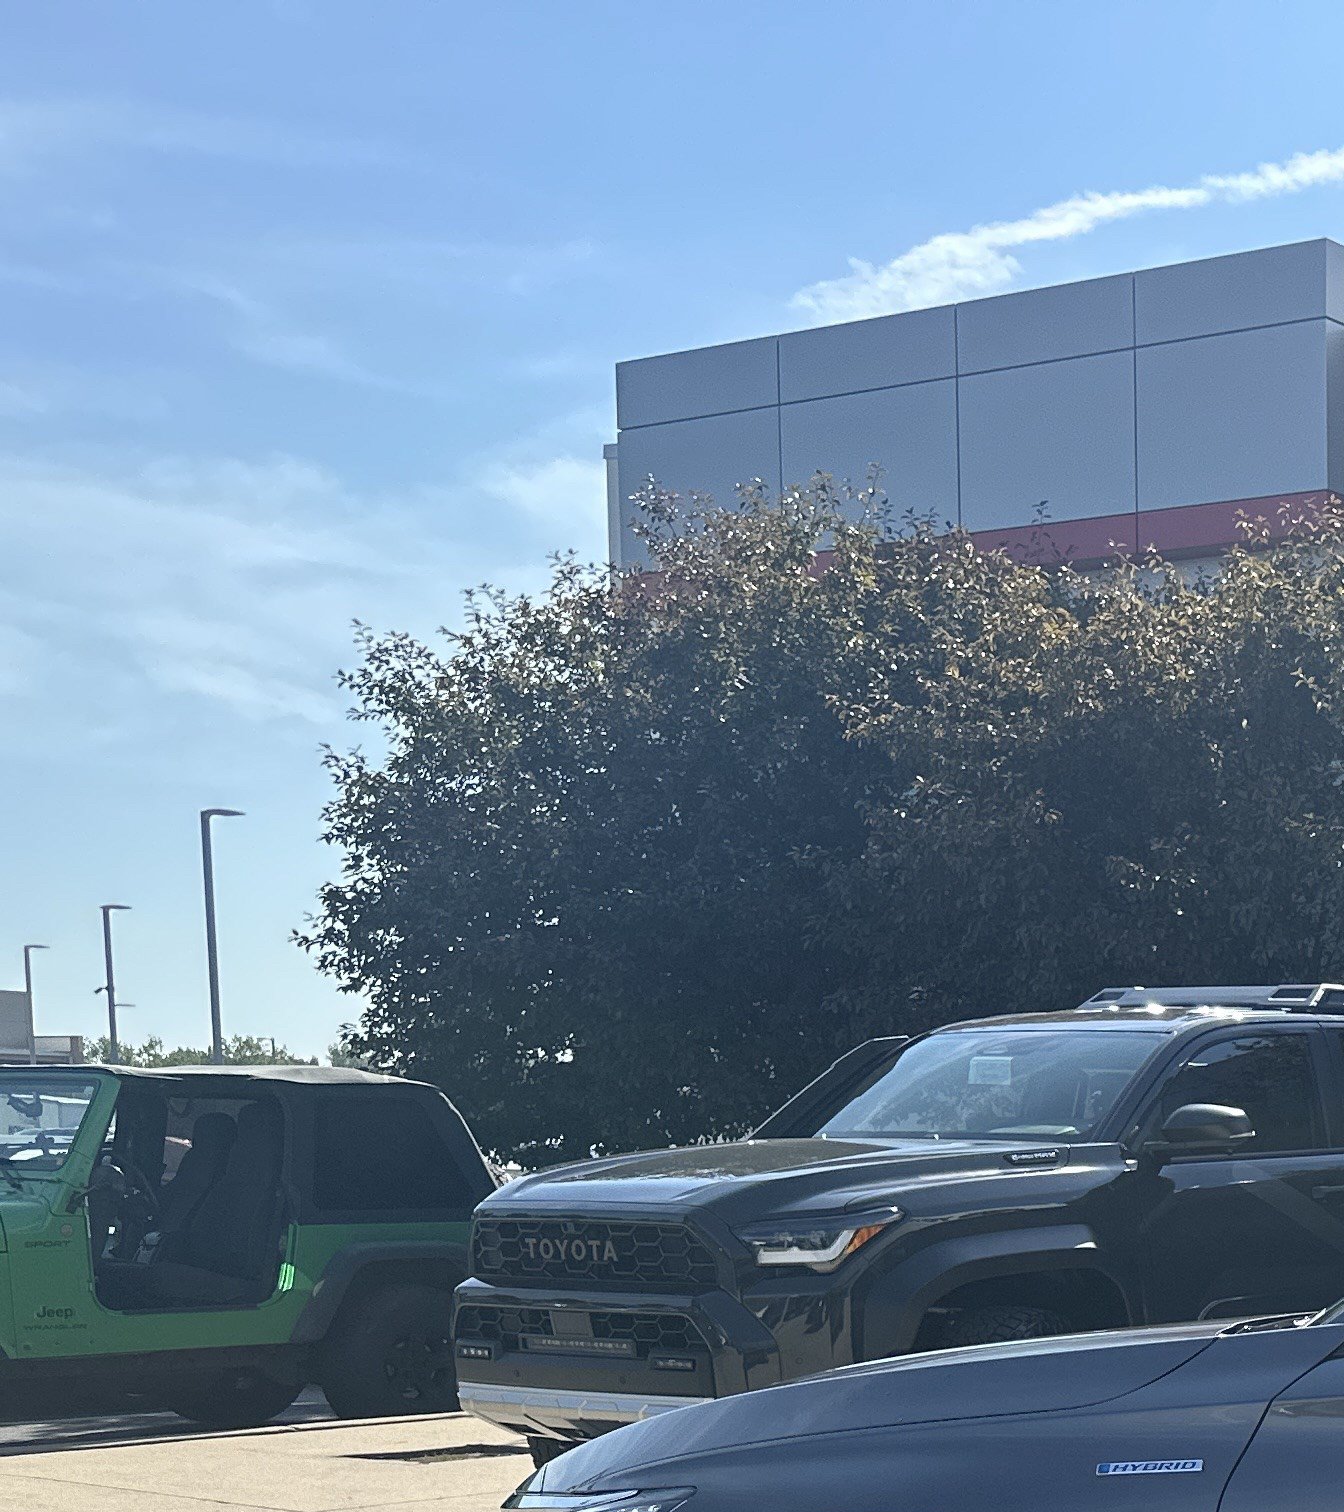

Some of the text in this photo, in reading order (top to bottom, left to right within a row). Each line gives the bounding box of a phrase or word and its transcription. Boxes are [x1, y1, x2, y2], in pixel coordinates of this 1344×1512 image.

[24, 1240, 71, 1249] SPORT
[525, 1238, 618, 1262] TOYOTA
[36, 1306, 73, 1319] Jeep
[1112, 1461, 1197, 1473] HYBRID
